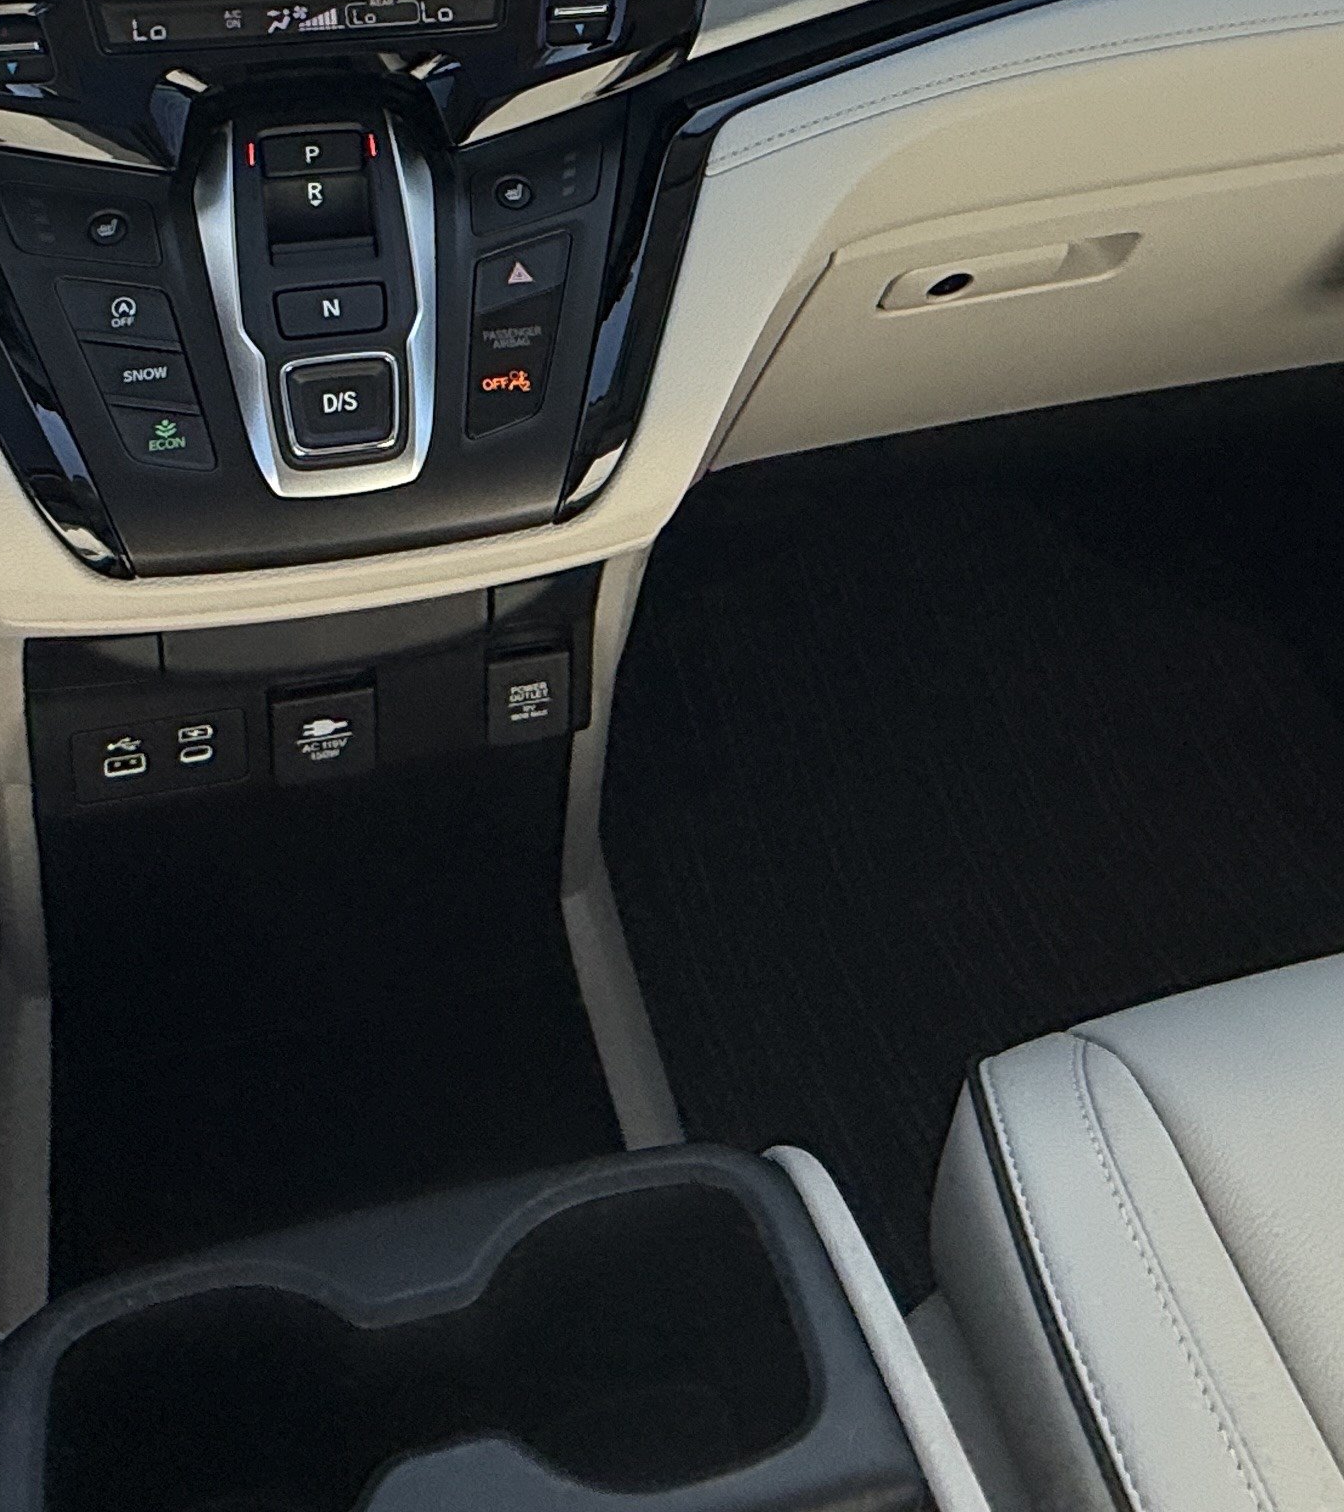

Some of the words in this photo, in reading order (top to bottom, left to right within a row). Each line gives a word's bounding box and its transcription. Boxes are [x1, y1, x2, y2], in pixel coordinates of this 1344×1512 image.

[352, 8, 376, 25] Lo
[420, 1, 454, 24] Lo
[132, 18, 167, 42] Lo
[304, 145, 320, 163] P
[307, 182, 323, 200] R
[322, 299, 341, 318] N
[110, 315, 135, 328] OFF
[482, 325, 542, 342] PASSENGER
[493, 336, 531, 349] AIRBAG
[122, 366, 168, 383] SNOW
[482, 376, 509, 391] OFF
[322, 391, 358, 414] D/S
[148, 436, 186, 451] ECON
[510, 681, 548, 694] POWER
[301, 742, 321, 754] AC
